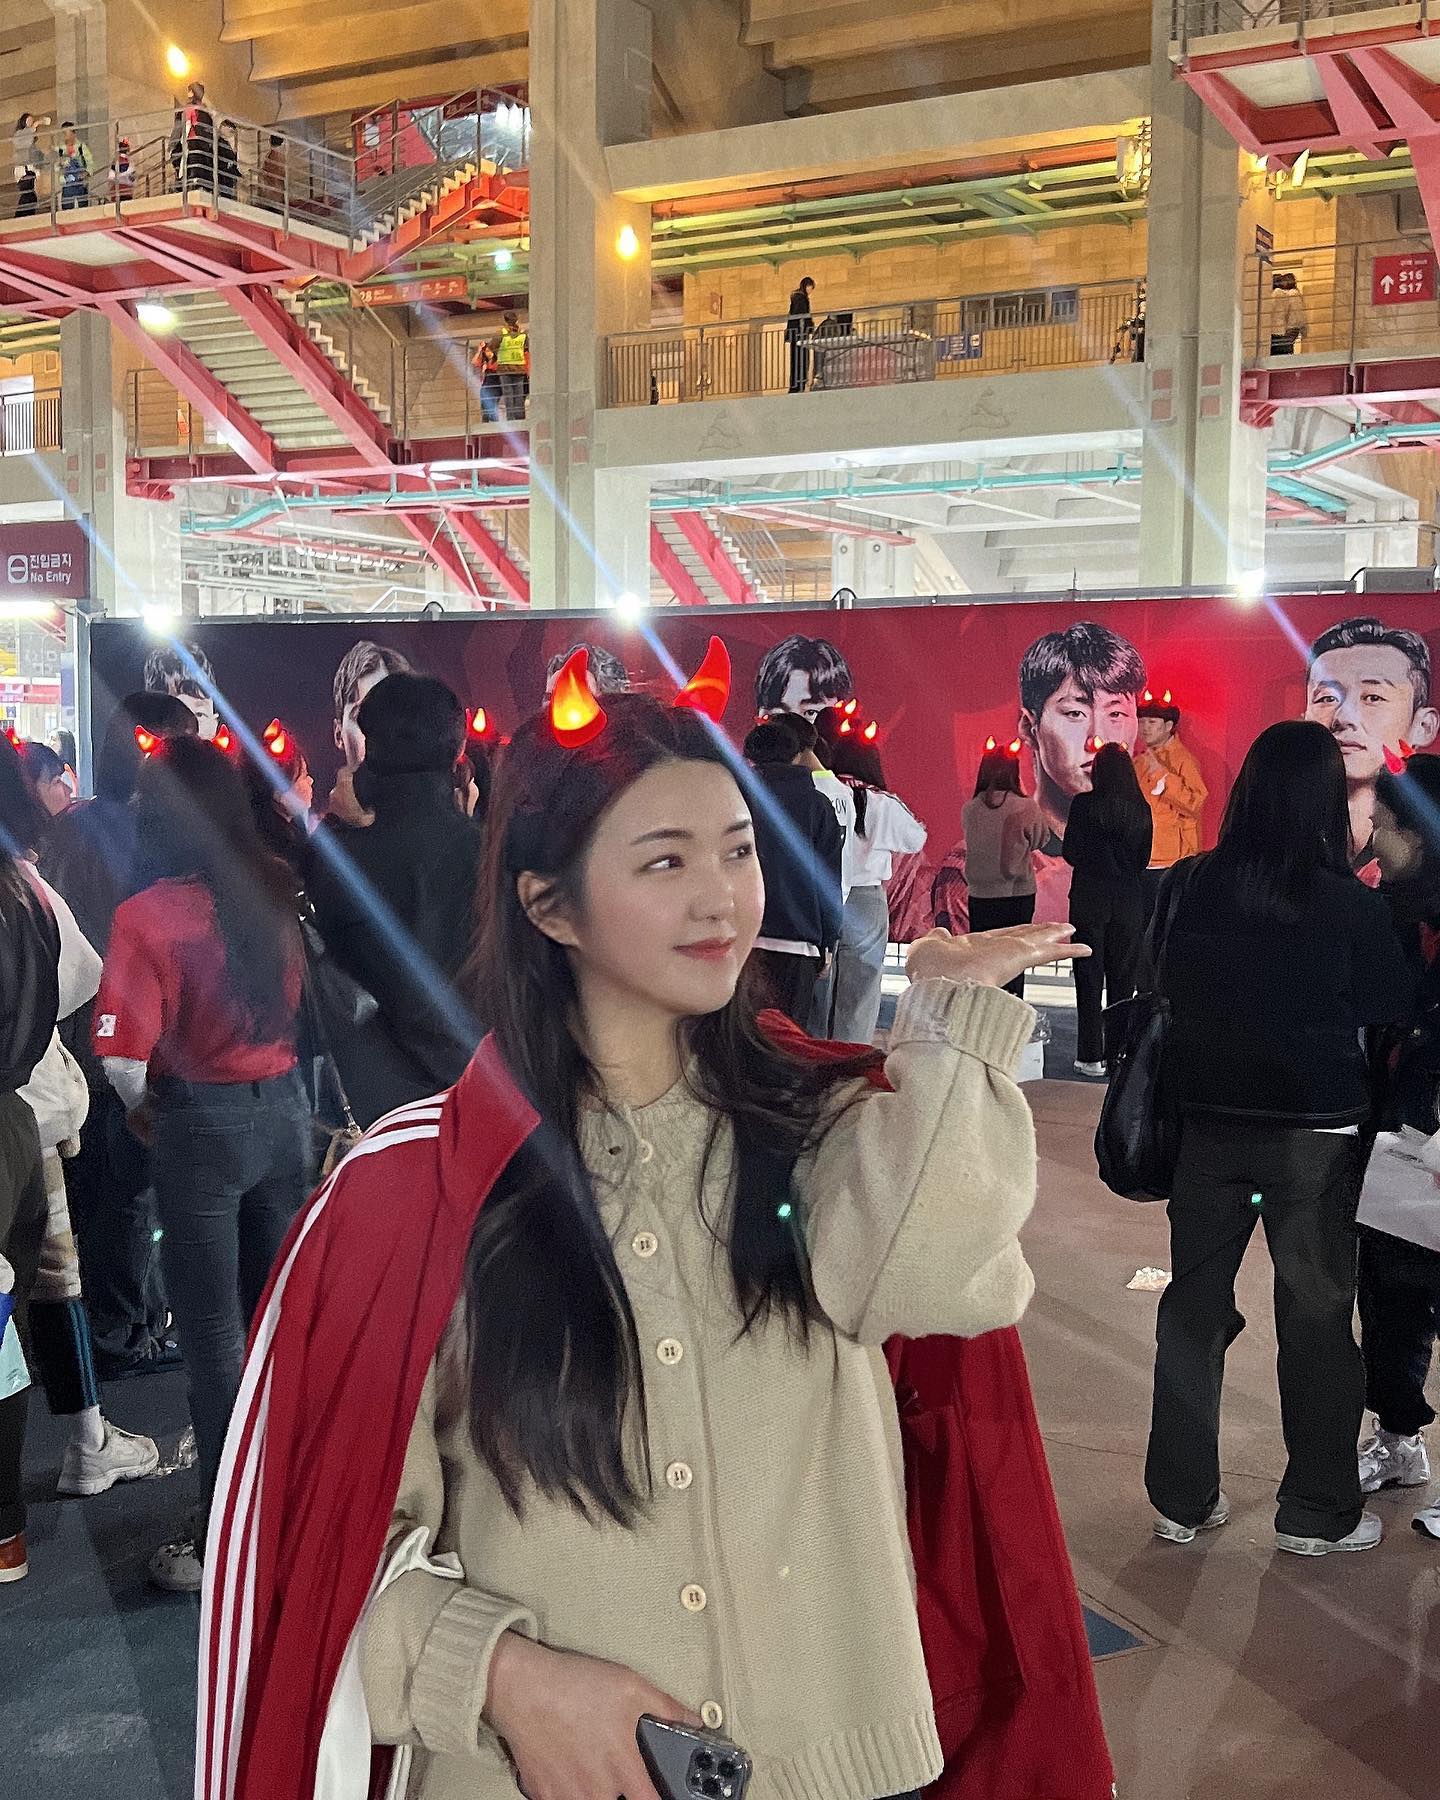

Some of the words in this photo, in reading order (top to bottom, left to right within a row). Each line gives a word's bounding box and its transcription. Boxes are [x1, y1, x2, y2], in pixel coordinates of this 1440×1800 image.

[1399, 269, 1423, 282] S16
[1399, 283, 1422, 294] S17
[30, 553, 71, 568] 진입금지
[31, 572, 43, 582] No
[46, 571, 71, 584] Entry
